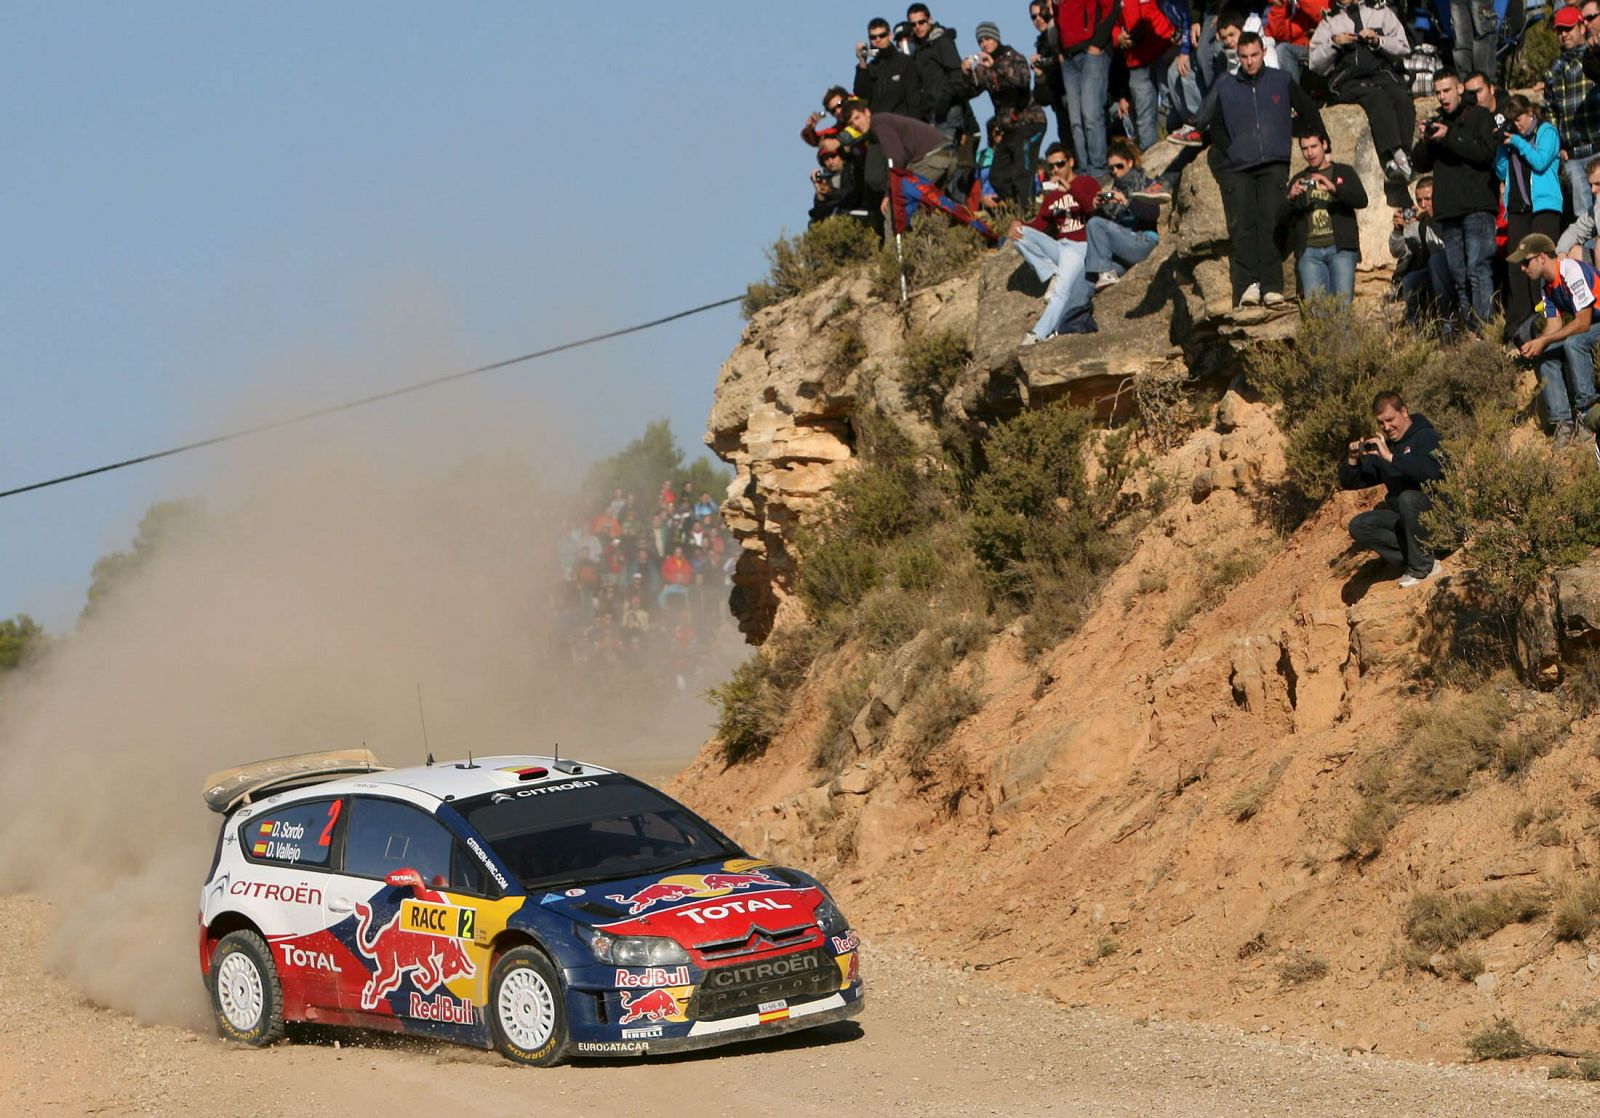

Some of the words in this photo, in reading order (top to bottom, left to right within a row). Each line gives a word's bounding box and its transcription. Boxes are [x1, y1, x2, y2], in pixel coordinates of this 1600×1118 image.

[272, 821, 280, 838] D.
[281, 822, 304, 840] Sordo
[318, 799, 342, 847] 2
[265, 841, 275, 858] D.
[276, 842, 301, 864] Vallejo
[466, 837, 509, 890] CITROEN-WRC.COM
[411, 906, 447, 931] RACC
[462, 909, 473, 938] 2
[676, 898, 792, 924] TOTAL
[279, 943, 342, 972] TOTAL
[410, 991, 440, 1021] Red
[441, 995, 474, 1025] Bull
[621, 1025, 663, 1039] PIRELLI
[578, 1042, 650, 1052] EURODATACAR
